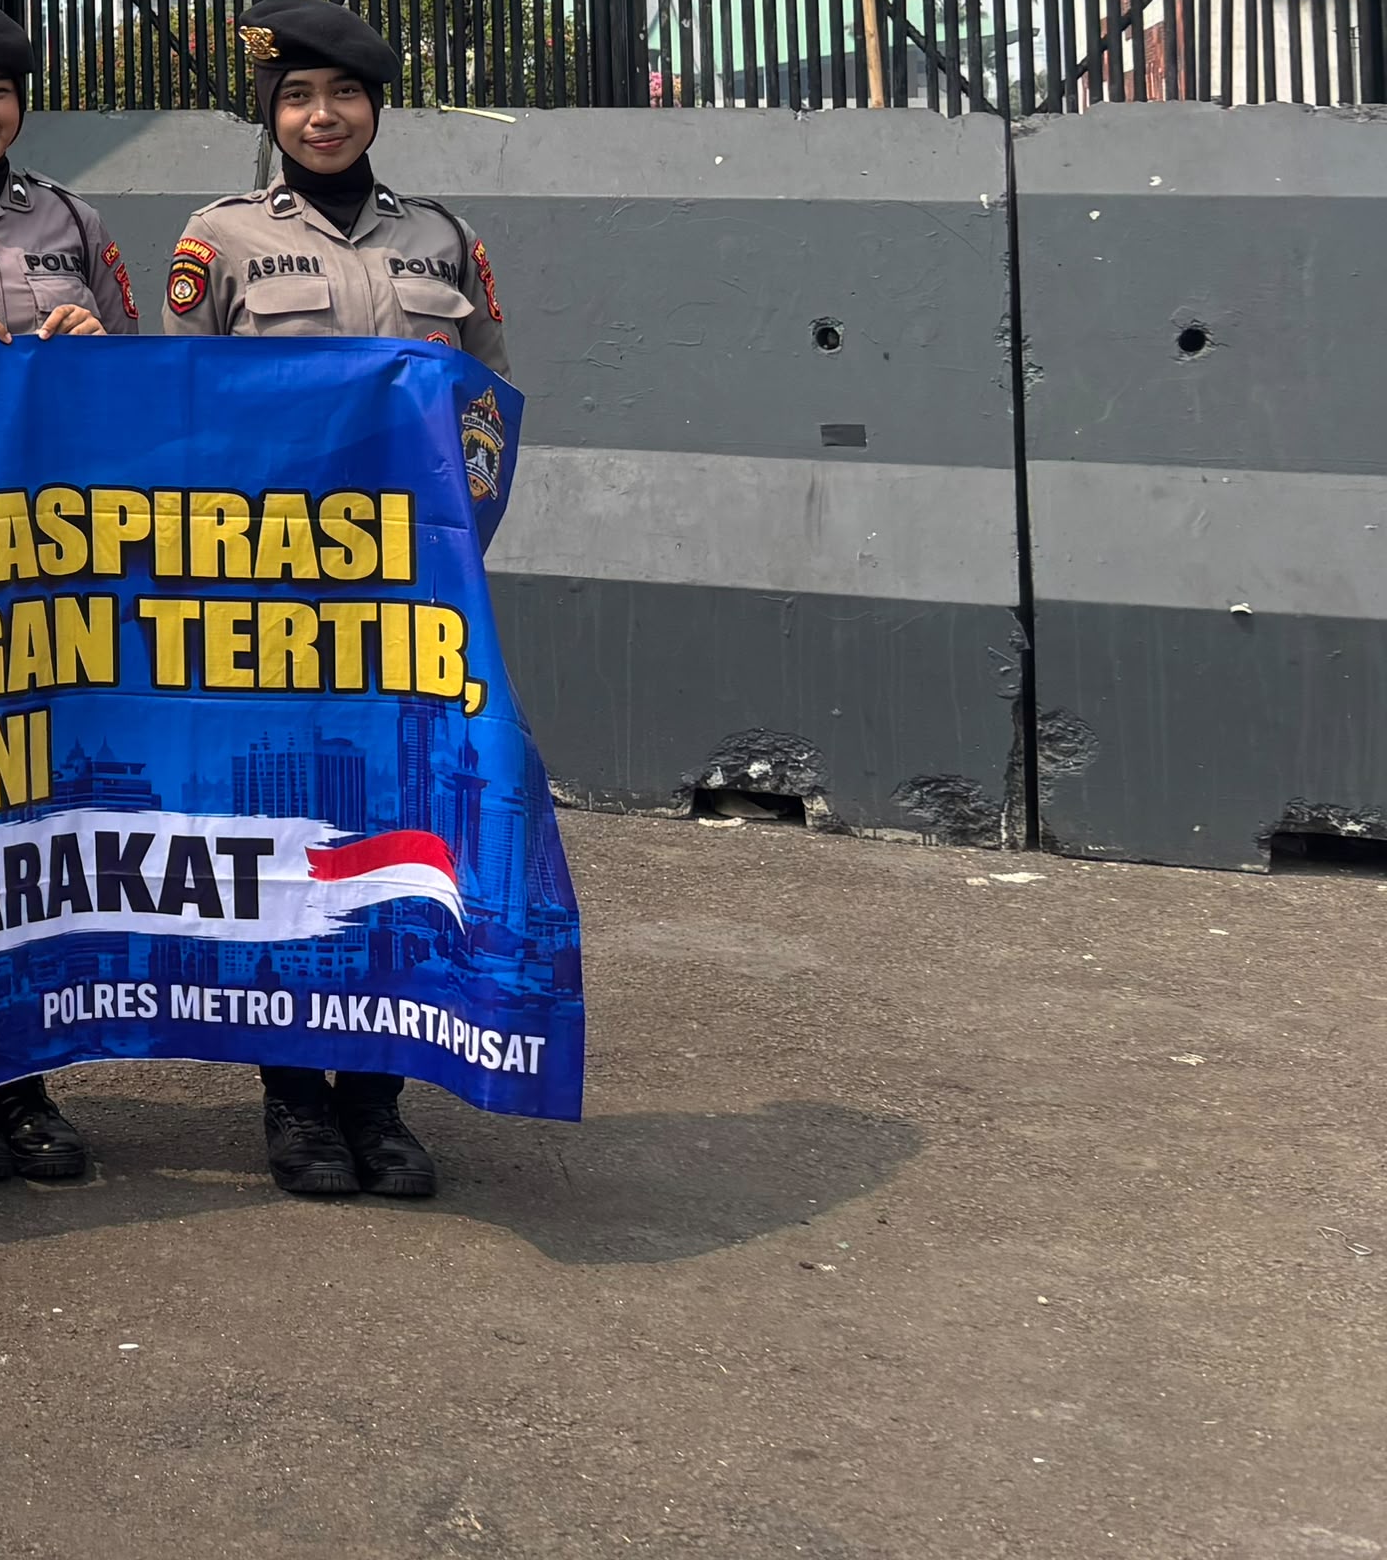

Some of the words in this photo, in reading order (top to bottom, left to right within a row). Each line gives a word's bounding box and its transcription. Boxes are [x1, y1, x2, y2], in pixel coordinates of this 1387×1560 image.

[247, 253, 321, 281] ASHRI
[389, 257, 458, 285] POLRI
[138, 598, 484, 715] TERTIB,
[42, 982, 158, 1030] POLRES
[169, 983, 294, 1028] METRO
